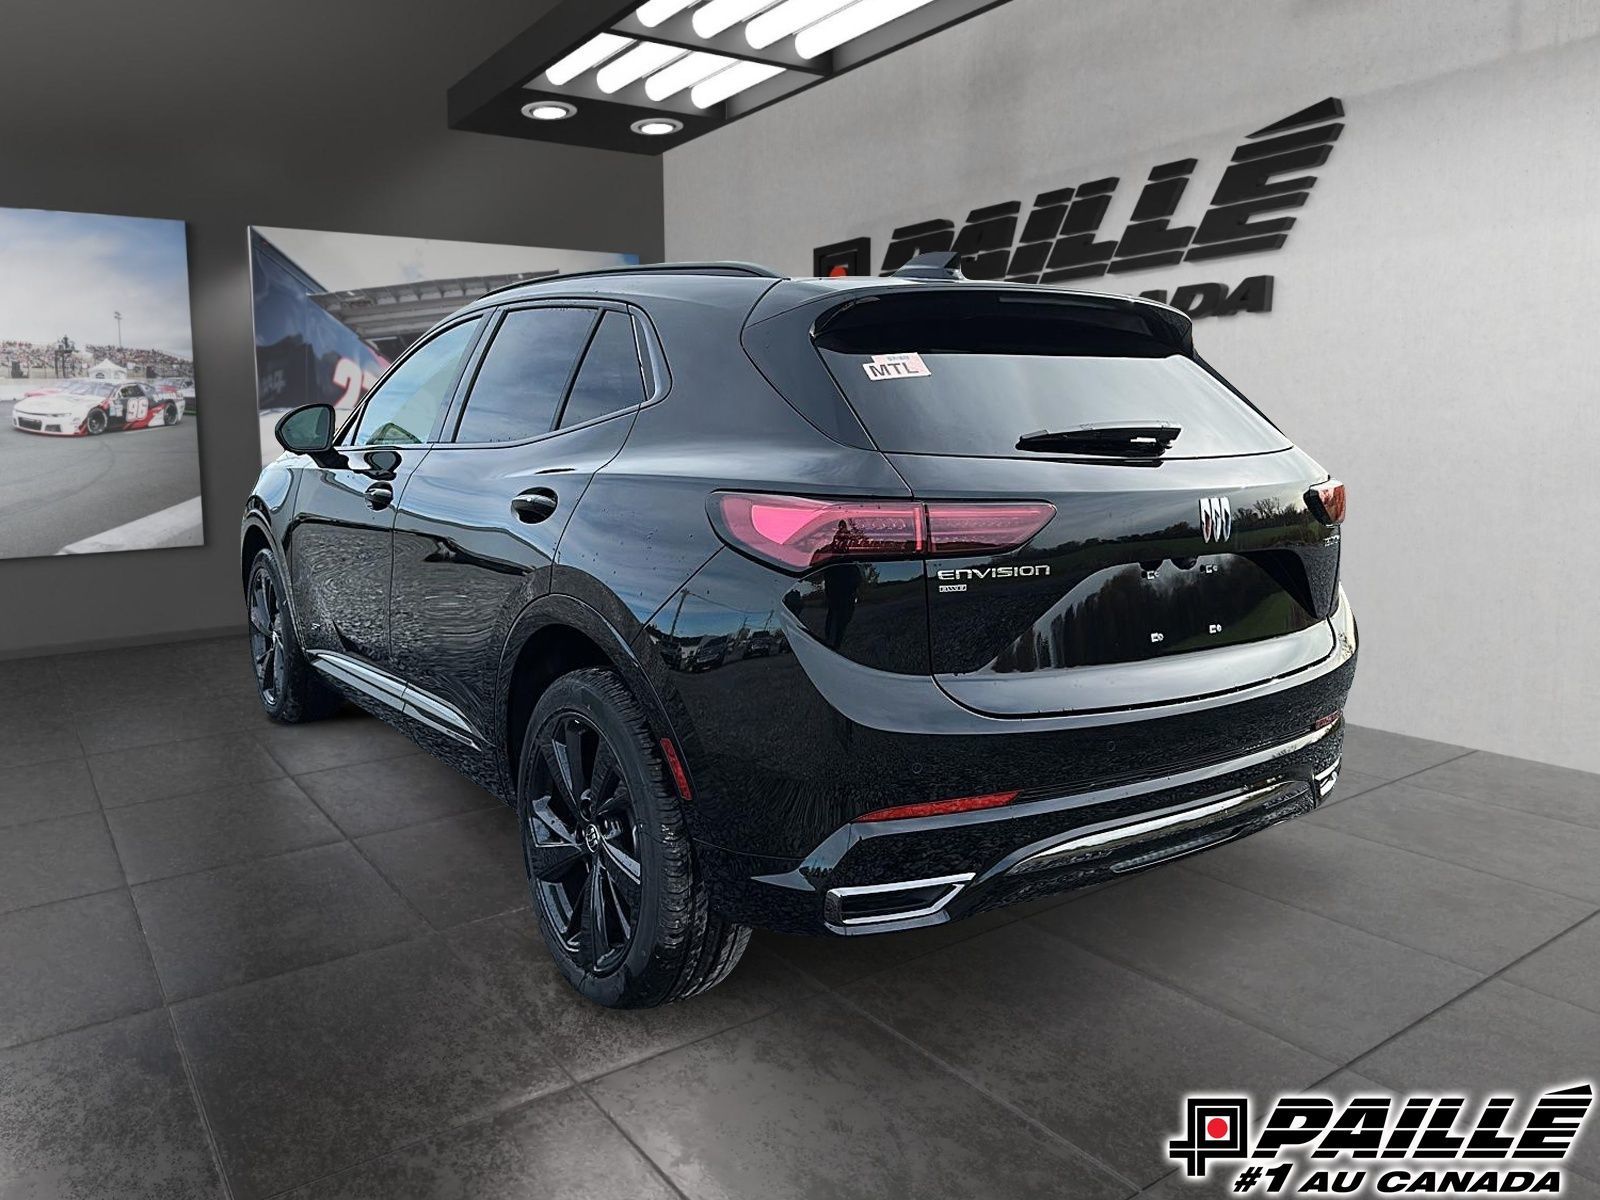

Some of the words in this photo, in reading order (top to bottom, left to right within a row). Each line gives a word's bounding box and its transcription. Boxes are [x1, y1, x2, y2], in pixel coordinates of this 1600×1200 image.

[868, 362, 919, 377] MTL
[126, 397, 149, 422] 96
[937, 565, 1051, 580] ENVISION
